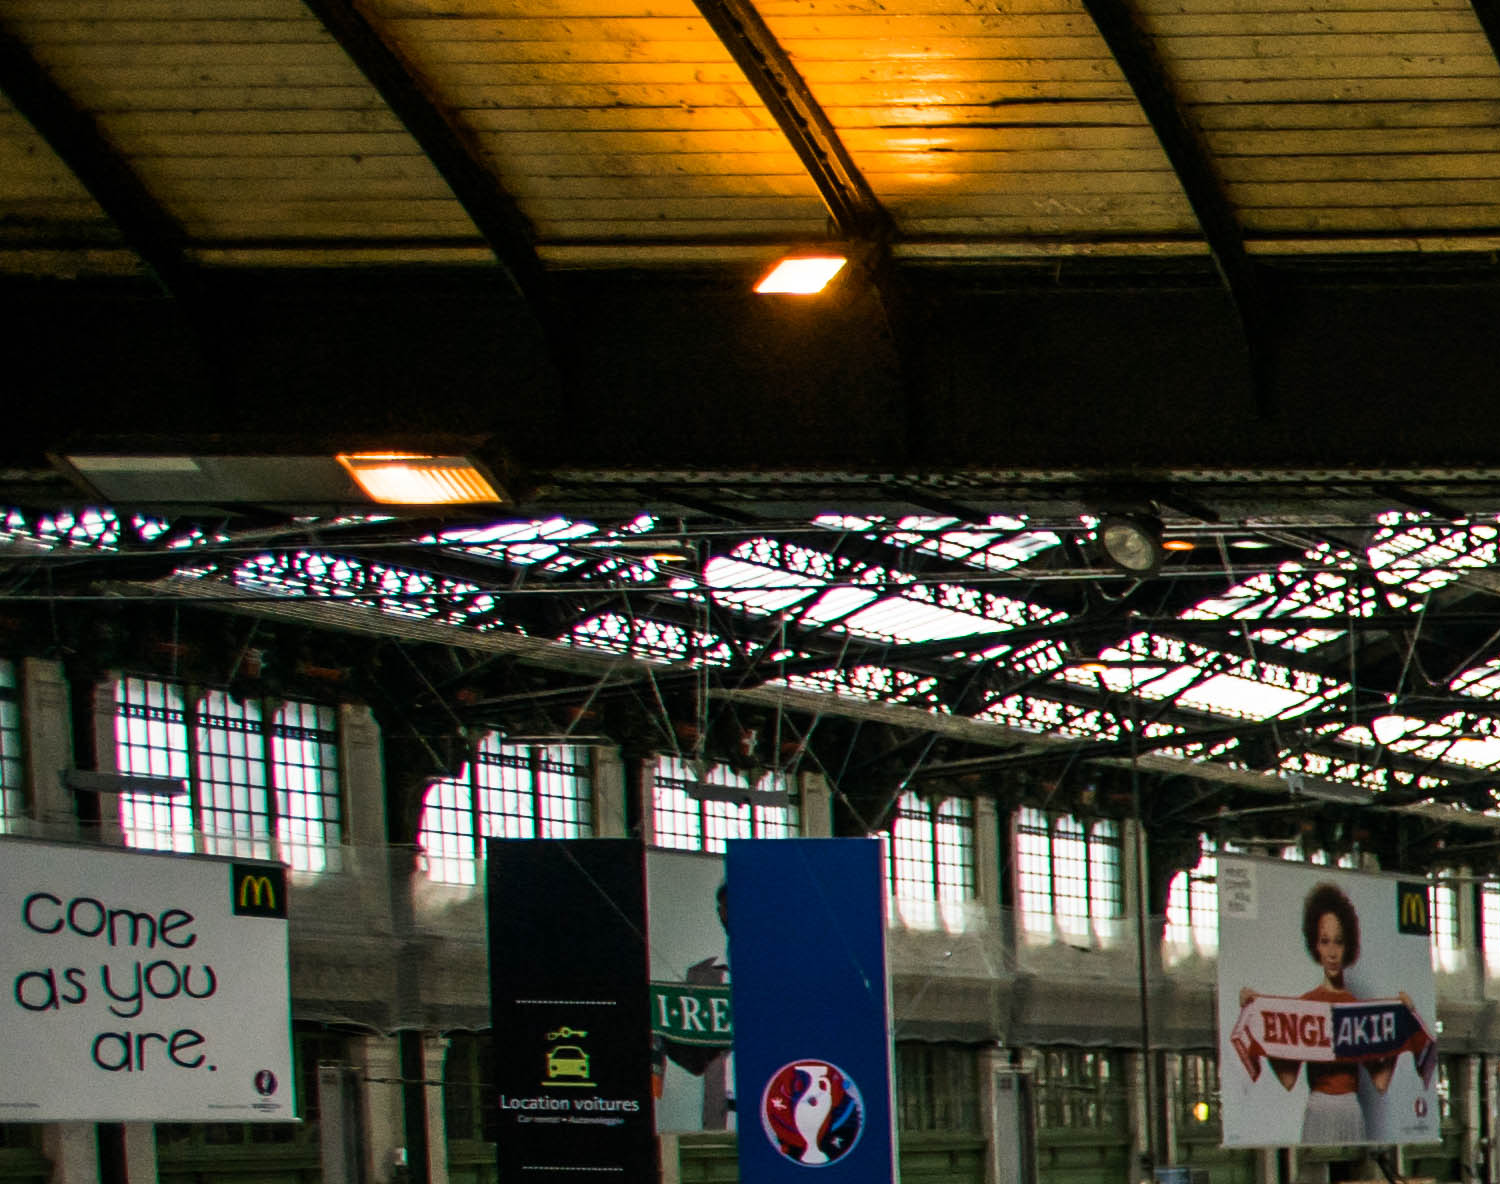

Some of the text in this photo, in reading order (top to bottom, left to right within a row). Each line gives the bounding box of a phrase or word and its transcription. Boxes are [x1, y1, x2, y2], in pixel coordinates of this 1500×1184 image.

[22, 892, 198, 949] come
[14, 960, 217, 1018] as you
[91, 1029, 218, 1072] are.
[1261, 1011, 1331, 1048] ENGL
[501, 1094, 640, 1112] Location voitures
